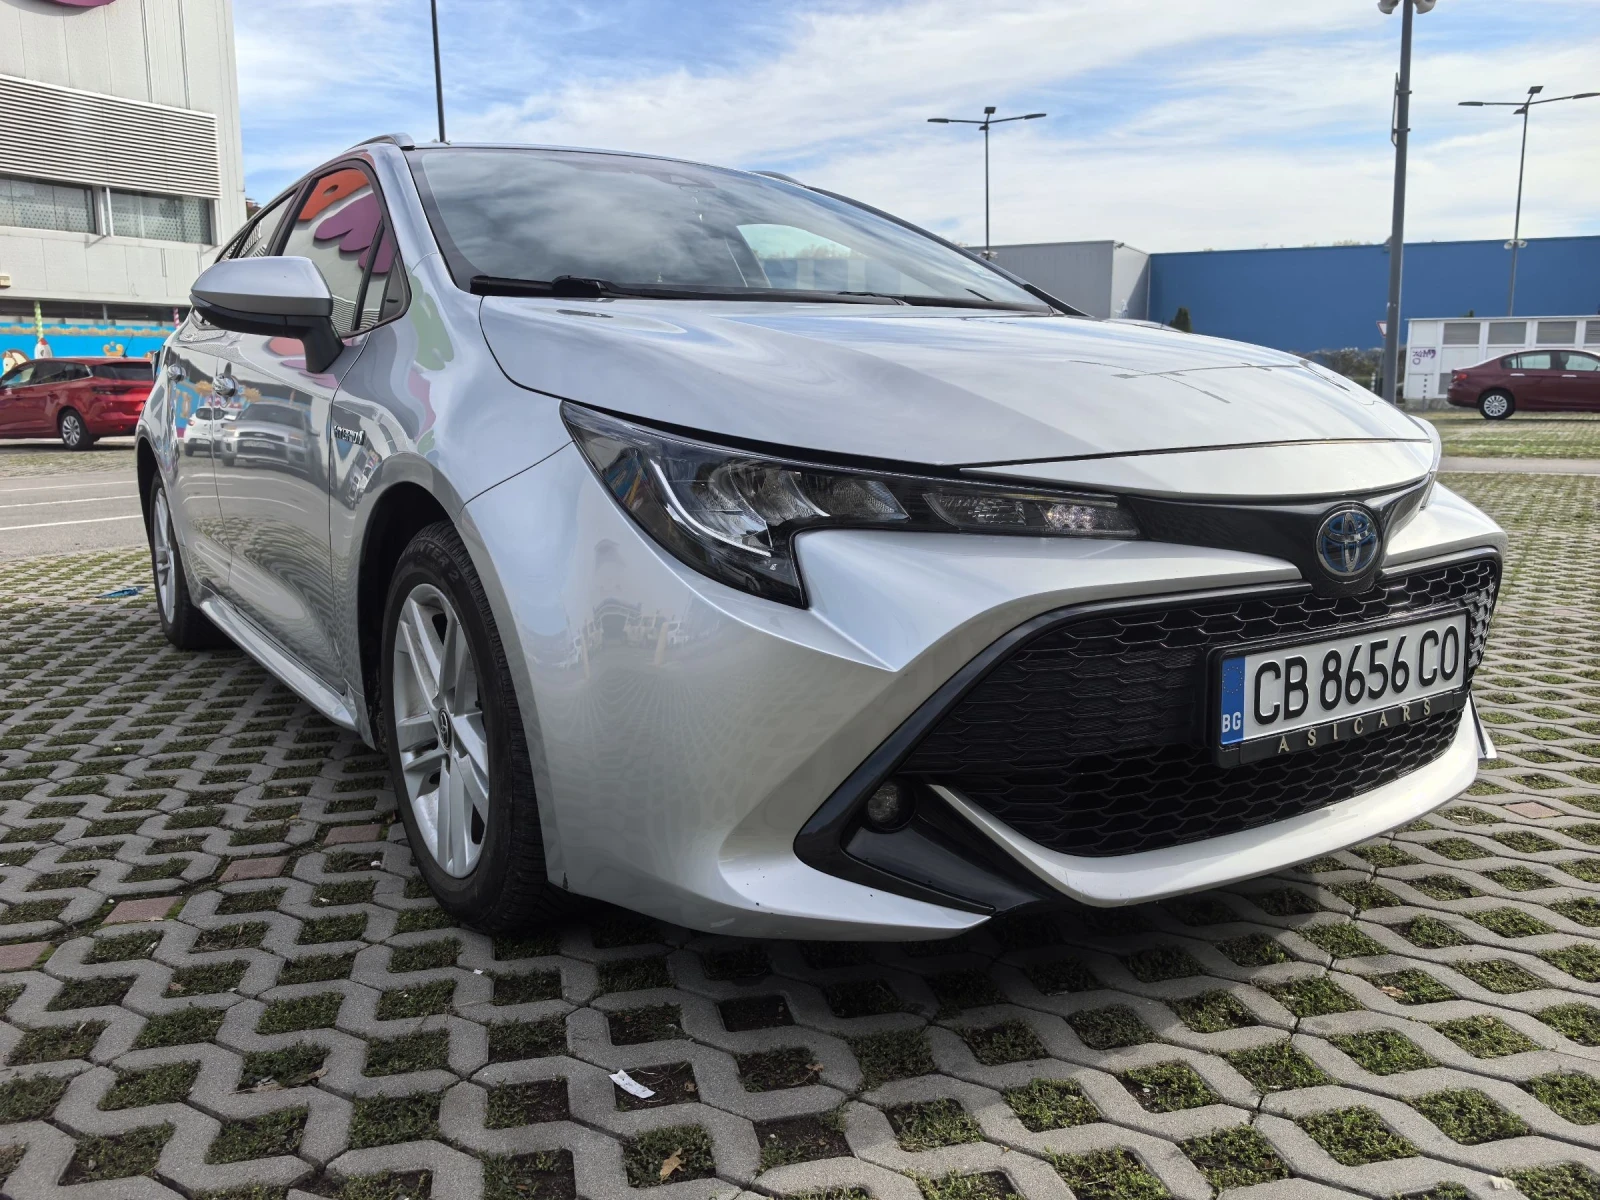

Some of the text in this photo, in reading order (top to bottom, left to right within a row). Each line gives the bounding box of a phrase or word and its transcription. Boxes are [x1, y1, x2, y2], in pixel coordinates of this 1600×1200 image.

[1253, 625, 1460, 725] CB 8656 CO
[1221, 711, 1242, 733] BG
[1277, 698, 1431, 754] ASICARS
